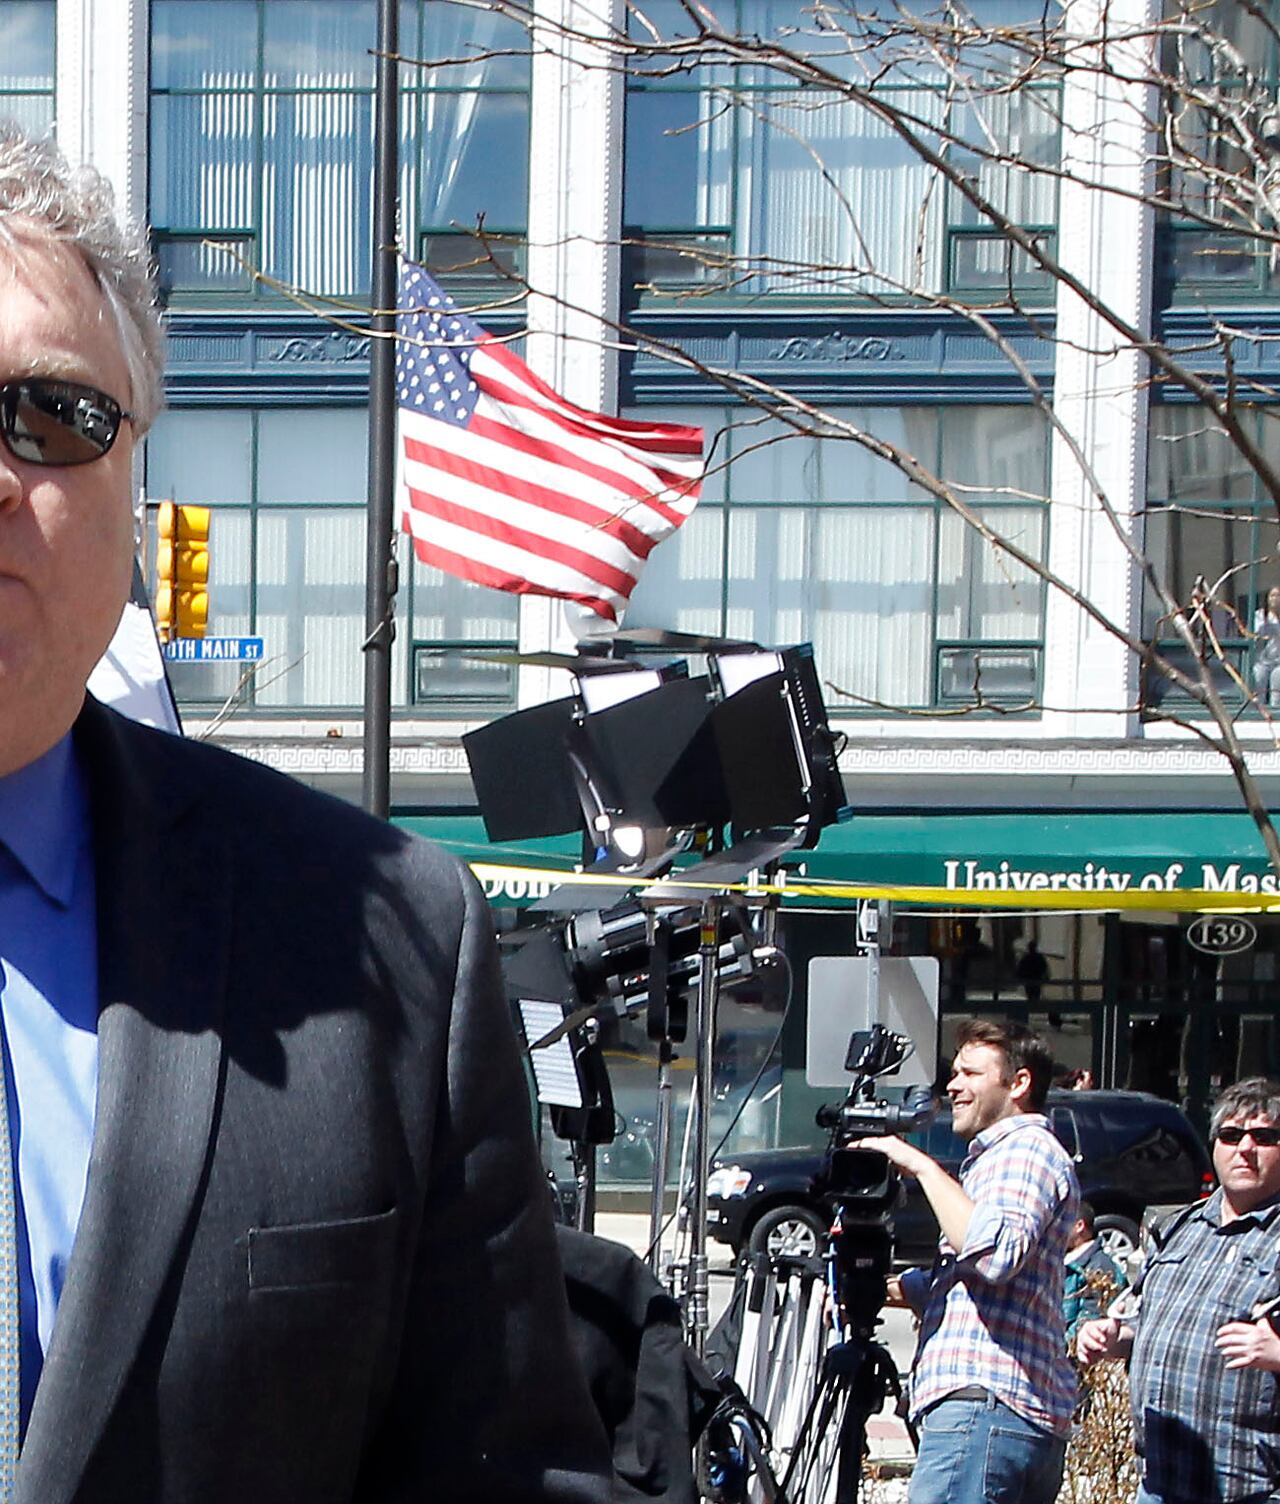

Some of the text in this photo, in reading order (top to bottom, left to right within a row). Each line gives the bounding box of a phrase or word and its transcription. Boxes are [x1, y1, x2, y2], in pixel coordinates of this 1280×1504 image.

[162, 639, 259, 659] UTH MAIN ST
[943, 860, 1280, 896] University of Mas
[1200, 922, 1247, 946] 139
